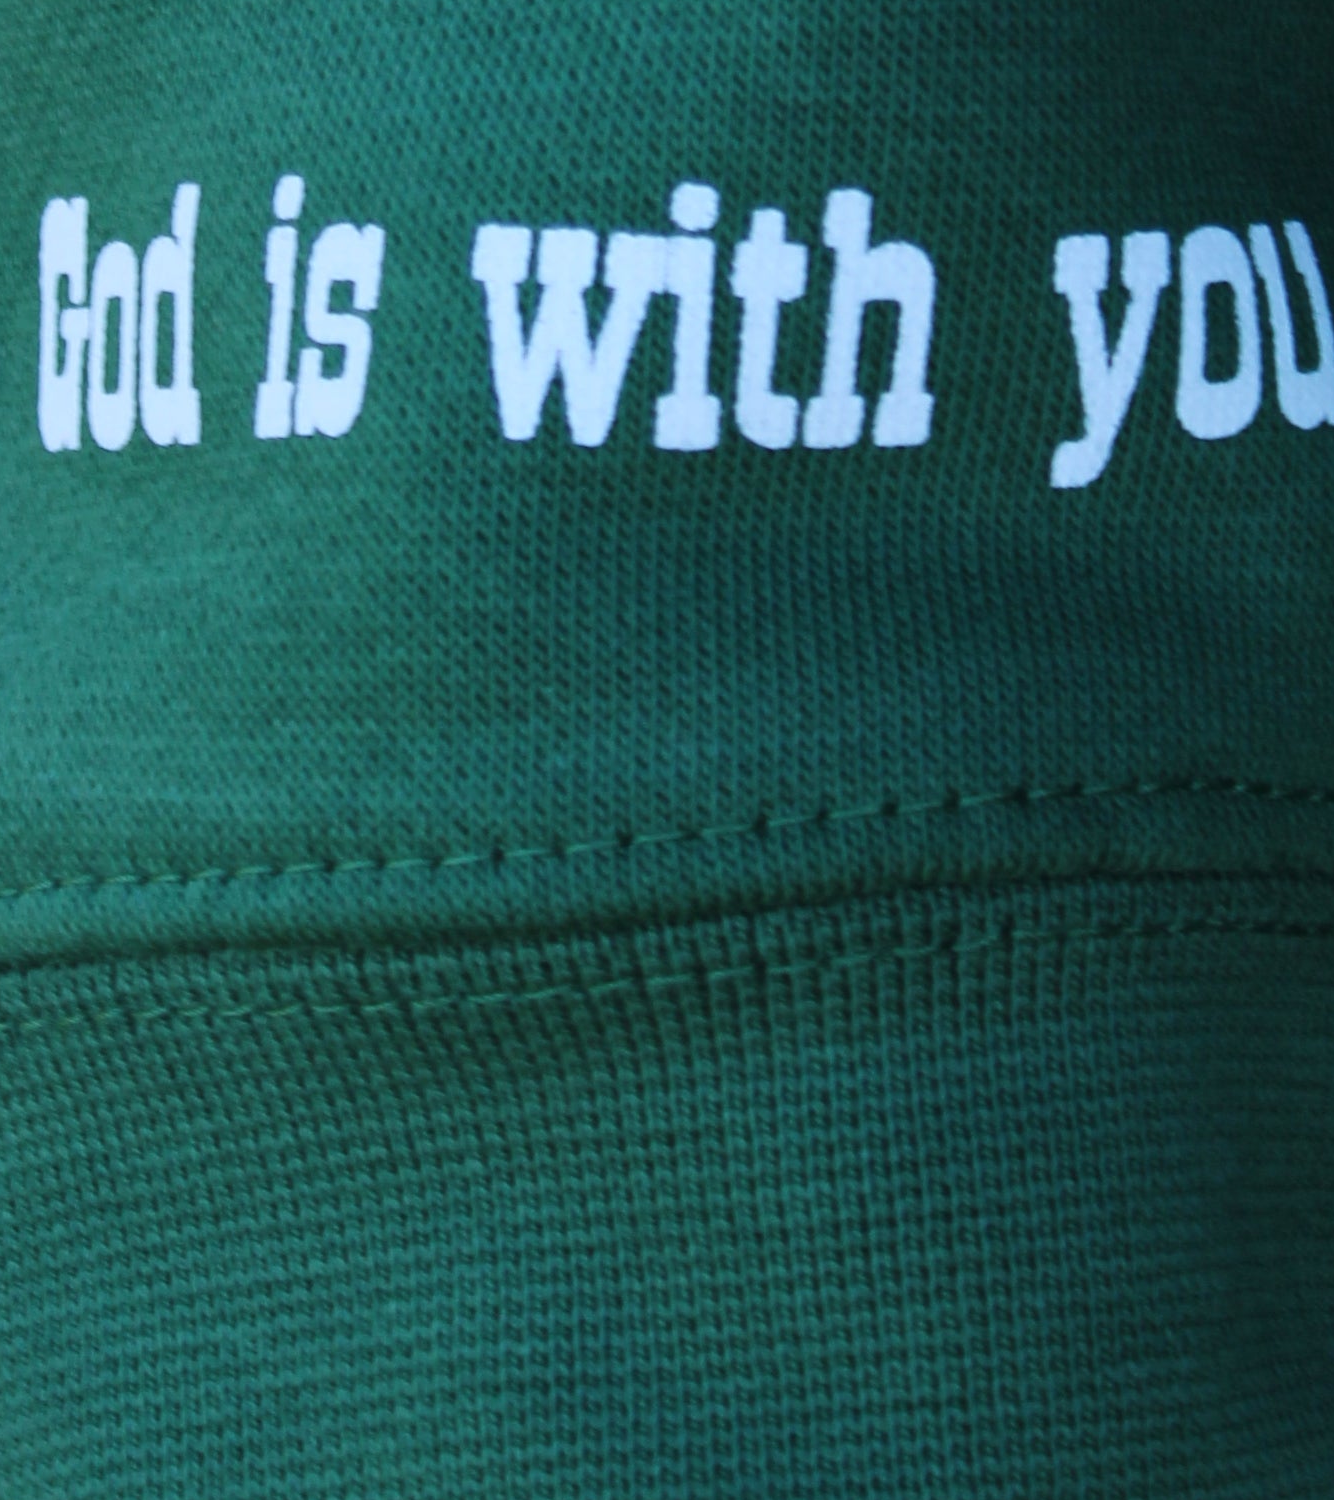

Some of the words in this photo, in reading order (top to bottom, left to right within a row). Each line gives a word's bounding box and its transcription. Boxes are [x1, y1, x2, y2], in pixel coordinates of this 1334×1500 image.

[38, 181, 201, 452] God
[254, 174, 386, 439] is
[471, 182, 935, 451] with
